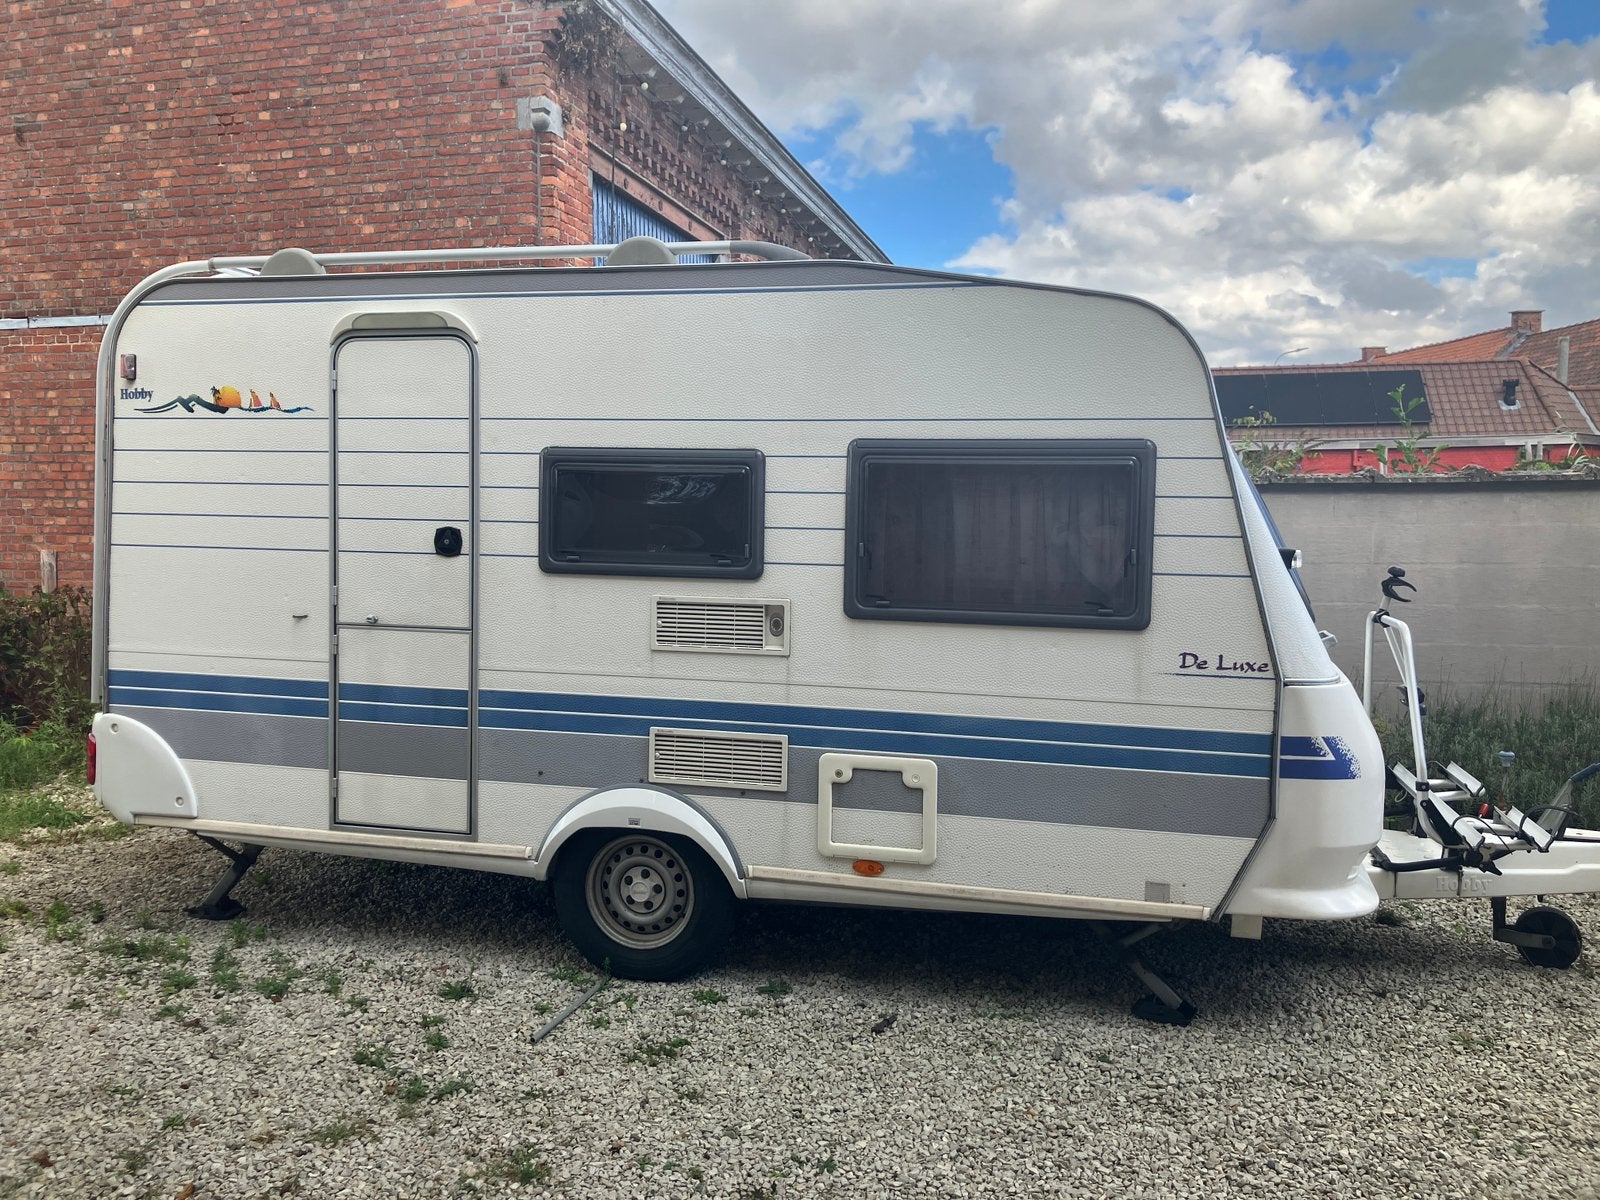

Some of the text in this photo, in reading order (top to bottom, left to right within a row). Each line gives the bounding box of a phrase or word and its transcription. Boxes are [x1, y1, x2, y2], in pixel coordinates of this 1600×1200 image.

[120, 387, 154, 402] Hobby
[1179, 652, 1269, 673] De Luxe
